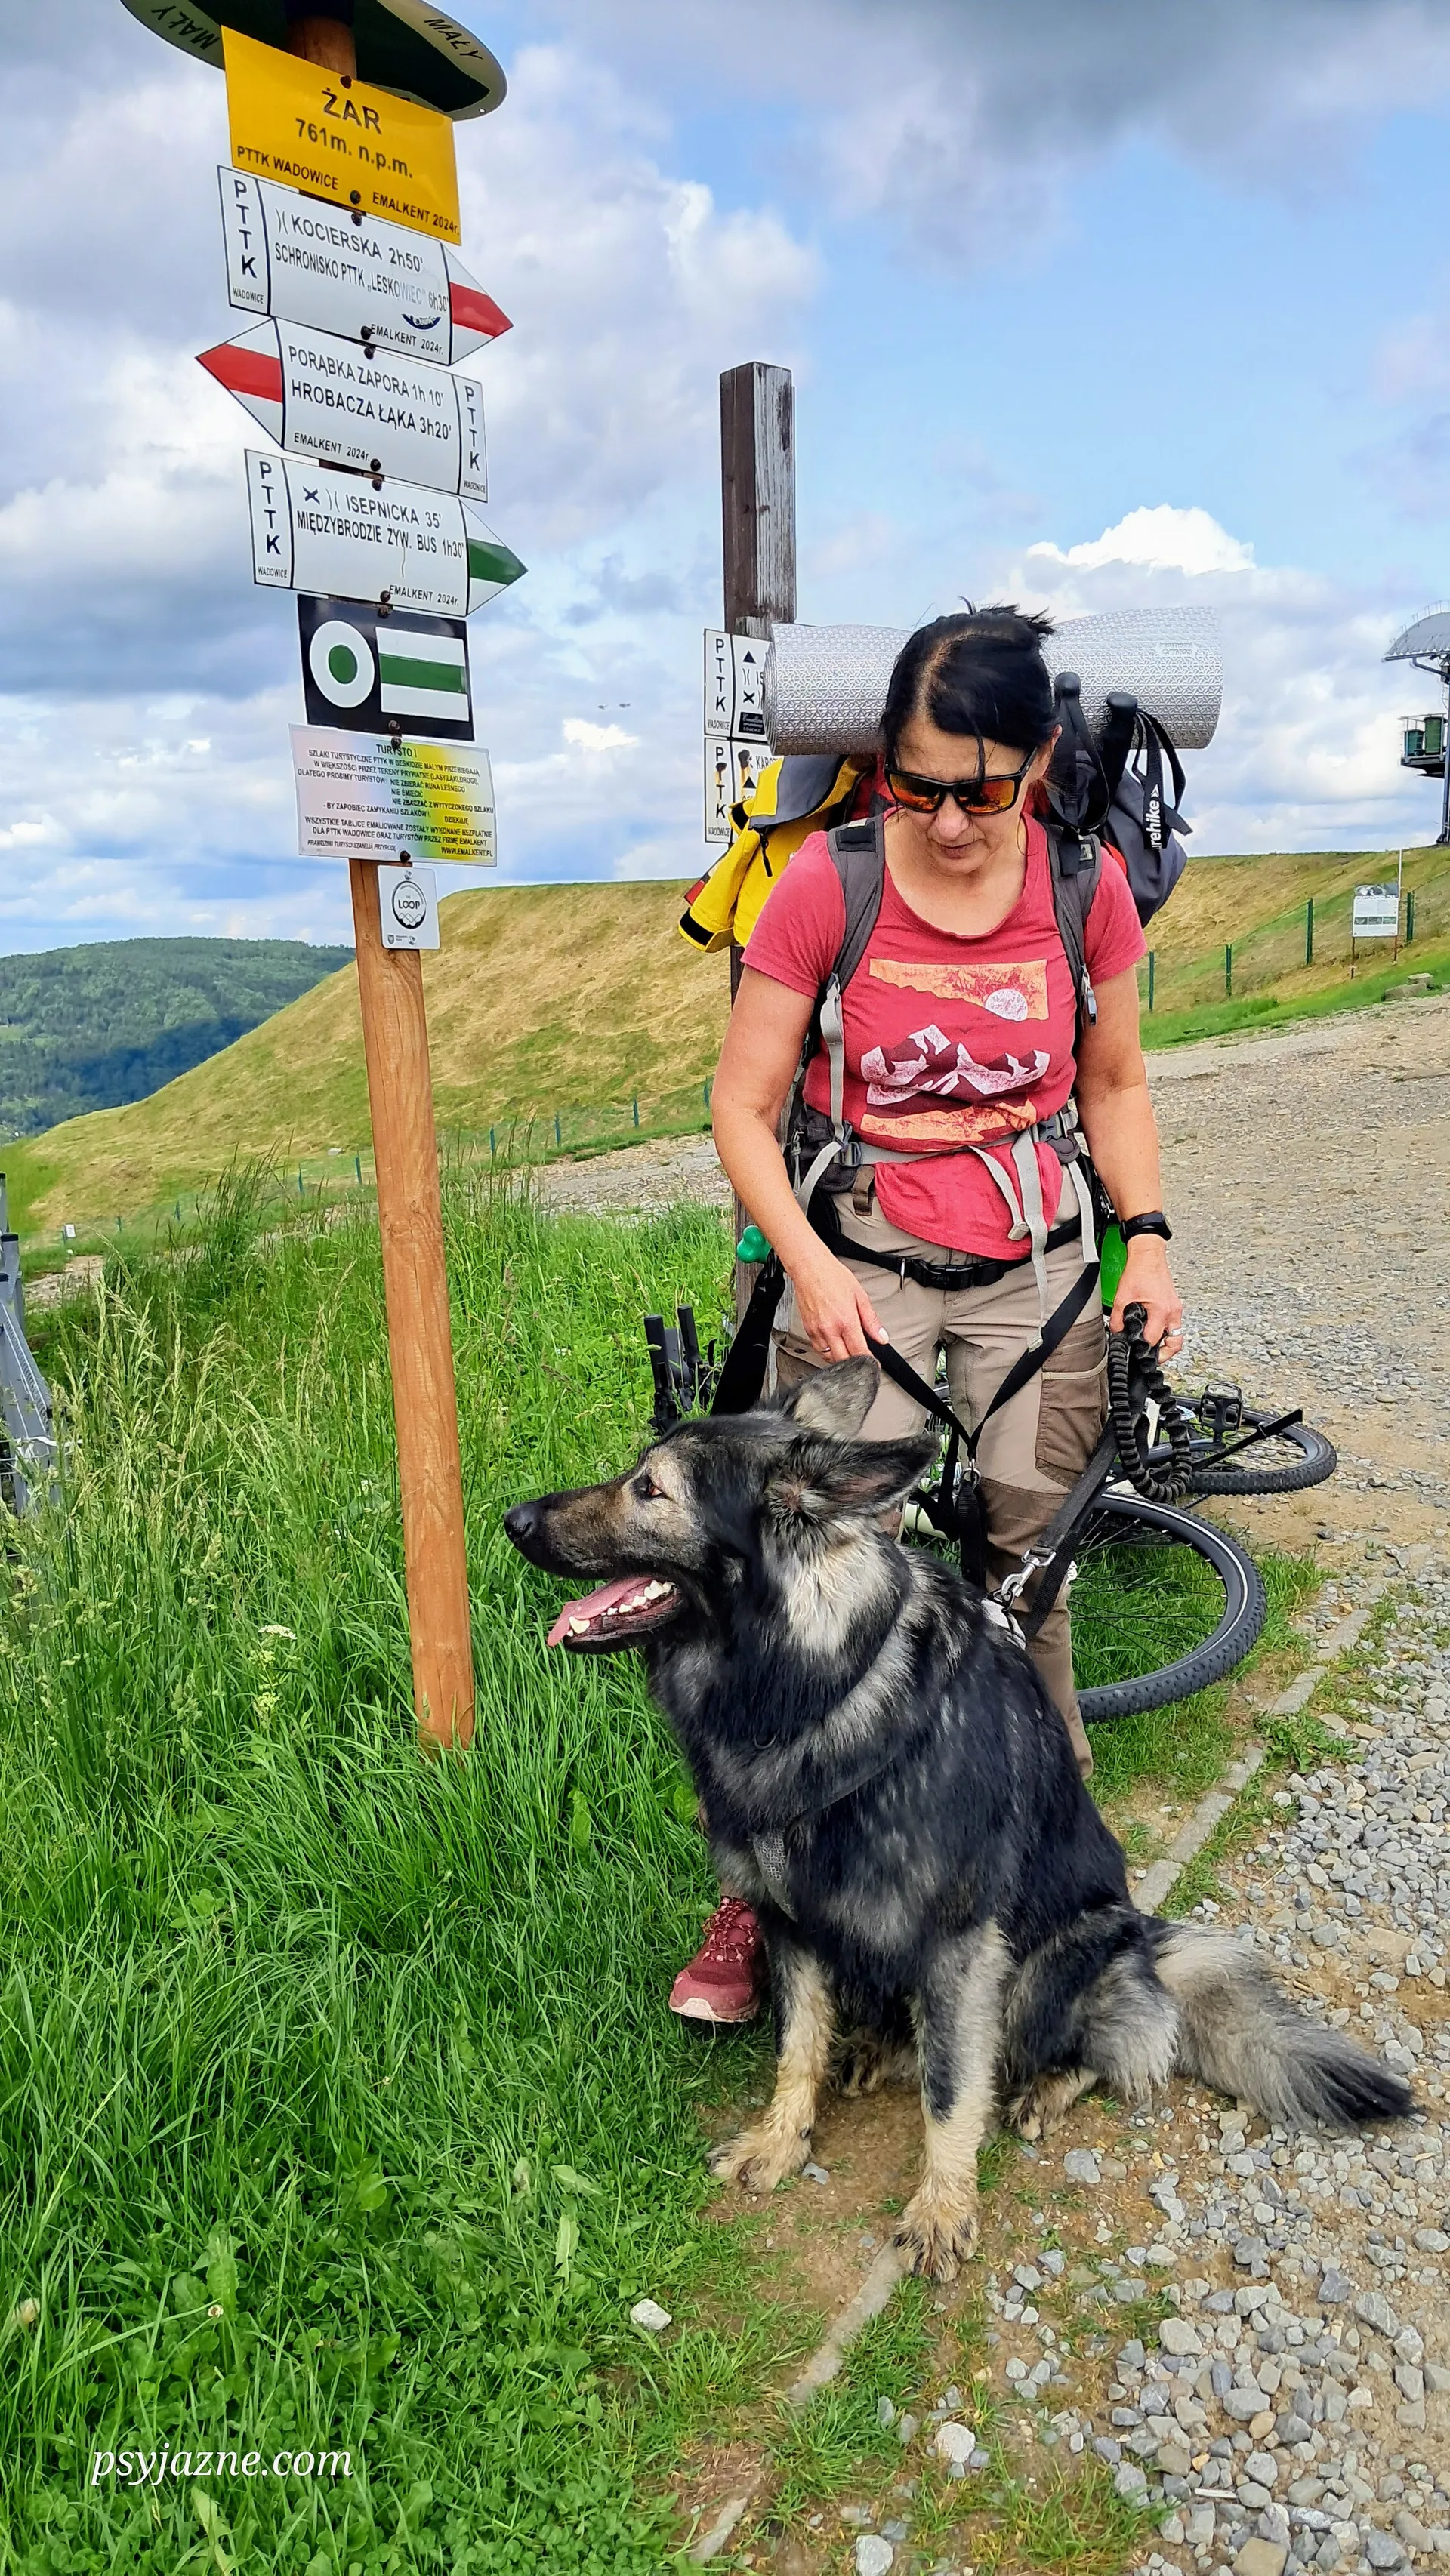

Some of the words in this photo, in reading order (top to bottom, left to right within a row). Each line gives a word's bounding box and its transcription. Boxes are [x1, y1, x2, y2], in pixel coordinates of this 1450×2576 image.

[151, 5, 220, 50] MAŁY
[424, 19, 483, 60] MAŁY
[321, 88, 382, 134] ŻAR
[237, 146, 270, 168] PTTK
[273, 156, 338, 190] WADOWICE
[295, 119, 352, 156] 761m.
[359, 144, 413, 179] n.p.m.
[234, 179, 258, 279] PTTK
[372, 193, 429, 223] EMALKENT
[433, 213, 460, 236] 2024r.
[291, 214, 382, 260] KOCIERSKA
[389, 247, 423, 272] 2h50'
[275, 242, 338, 279] SCHRONISKO
[341, 262, 365, 287] PTTK
[233, 286, 264, 304] WADOWICE
[371, 324, 417, 347] EMALKENT
[421, 339, 443, 355] 2024r.
[288, 345, 356, 382] PORĄBKA
[357, 366, 409, 399] ZAPORA
[412, 383, 424, 402] 1h
[291, 379, 375, 419] HROBACZA
[379, 403, 417, 432] ŁĄKA
[419, 417, 452, 440] 3h20'
[464, 385, 481, 471] PTTK
[294, 432, 342, 454] EMALKENT
[347, 446, 370, 462] 2024r.
[259, 461, 281, 555] PTTK
[346, 494, 420, 525] ISEPNICKA
[297, 510, 382, 543] MIĘDZYBRODZIE
[387, 523, 412, 549] ŻYW.
[417, 534, 437, 553] BUS
[258, 565, 287, 578] WADOWICE
[389, 584, 433, 601] EMALKENT
[437, 593, 459, 606] 2024r.
[715, 638, 726, 712] PTTK
[309, 750, 329, 758] SZLAKI
[331, 752, 372, 763] TURYSTYCZNE
[444, 765, 480, 777] PRZEBIEGAJĄ
[321, 761, 357, 771] WIĘKSZOŚCI
[378, 767, 399, 775] TERENY
[327, 771, 353, 781] PROSIMY
[304, 816, 339, 826] WSZYSTKIE
[341, 819, 366, 828] TABLICE
[367, 821, 404, 830] EMALIOWANE
[430, 827, 461, 835] WYKONANE
[336, 803, 366, 812] ZAPOBIEC
[367, 806, 399, 815] ZAMYKANIU
[400, 808, 427, 817] SZLAKÓW
[342, 829, 375, 838] WADOWICE
[393, 833, 423, 841] TURYSTÓW
[460, 838, 487, 846] EMALKENT
[398, 899, 420, 909] LOOP
